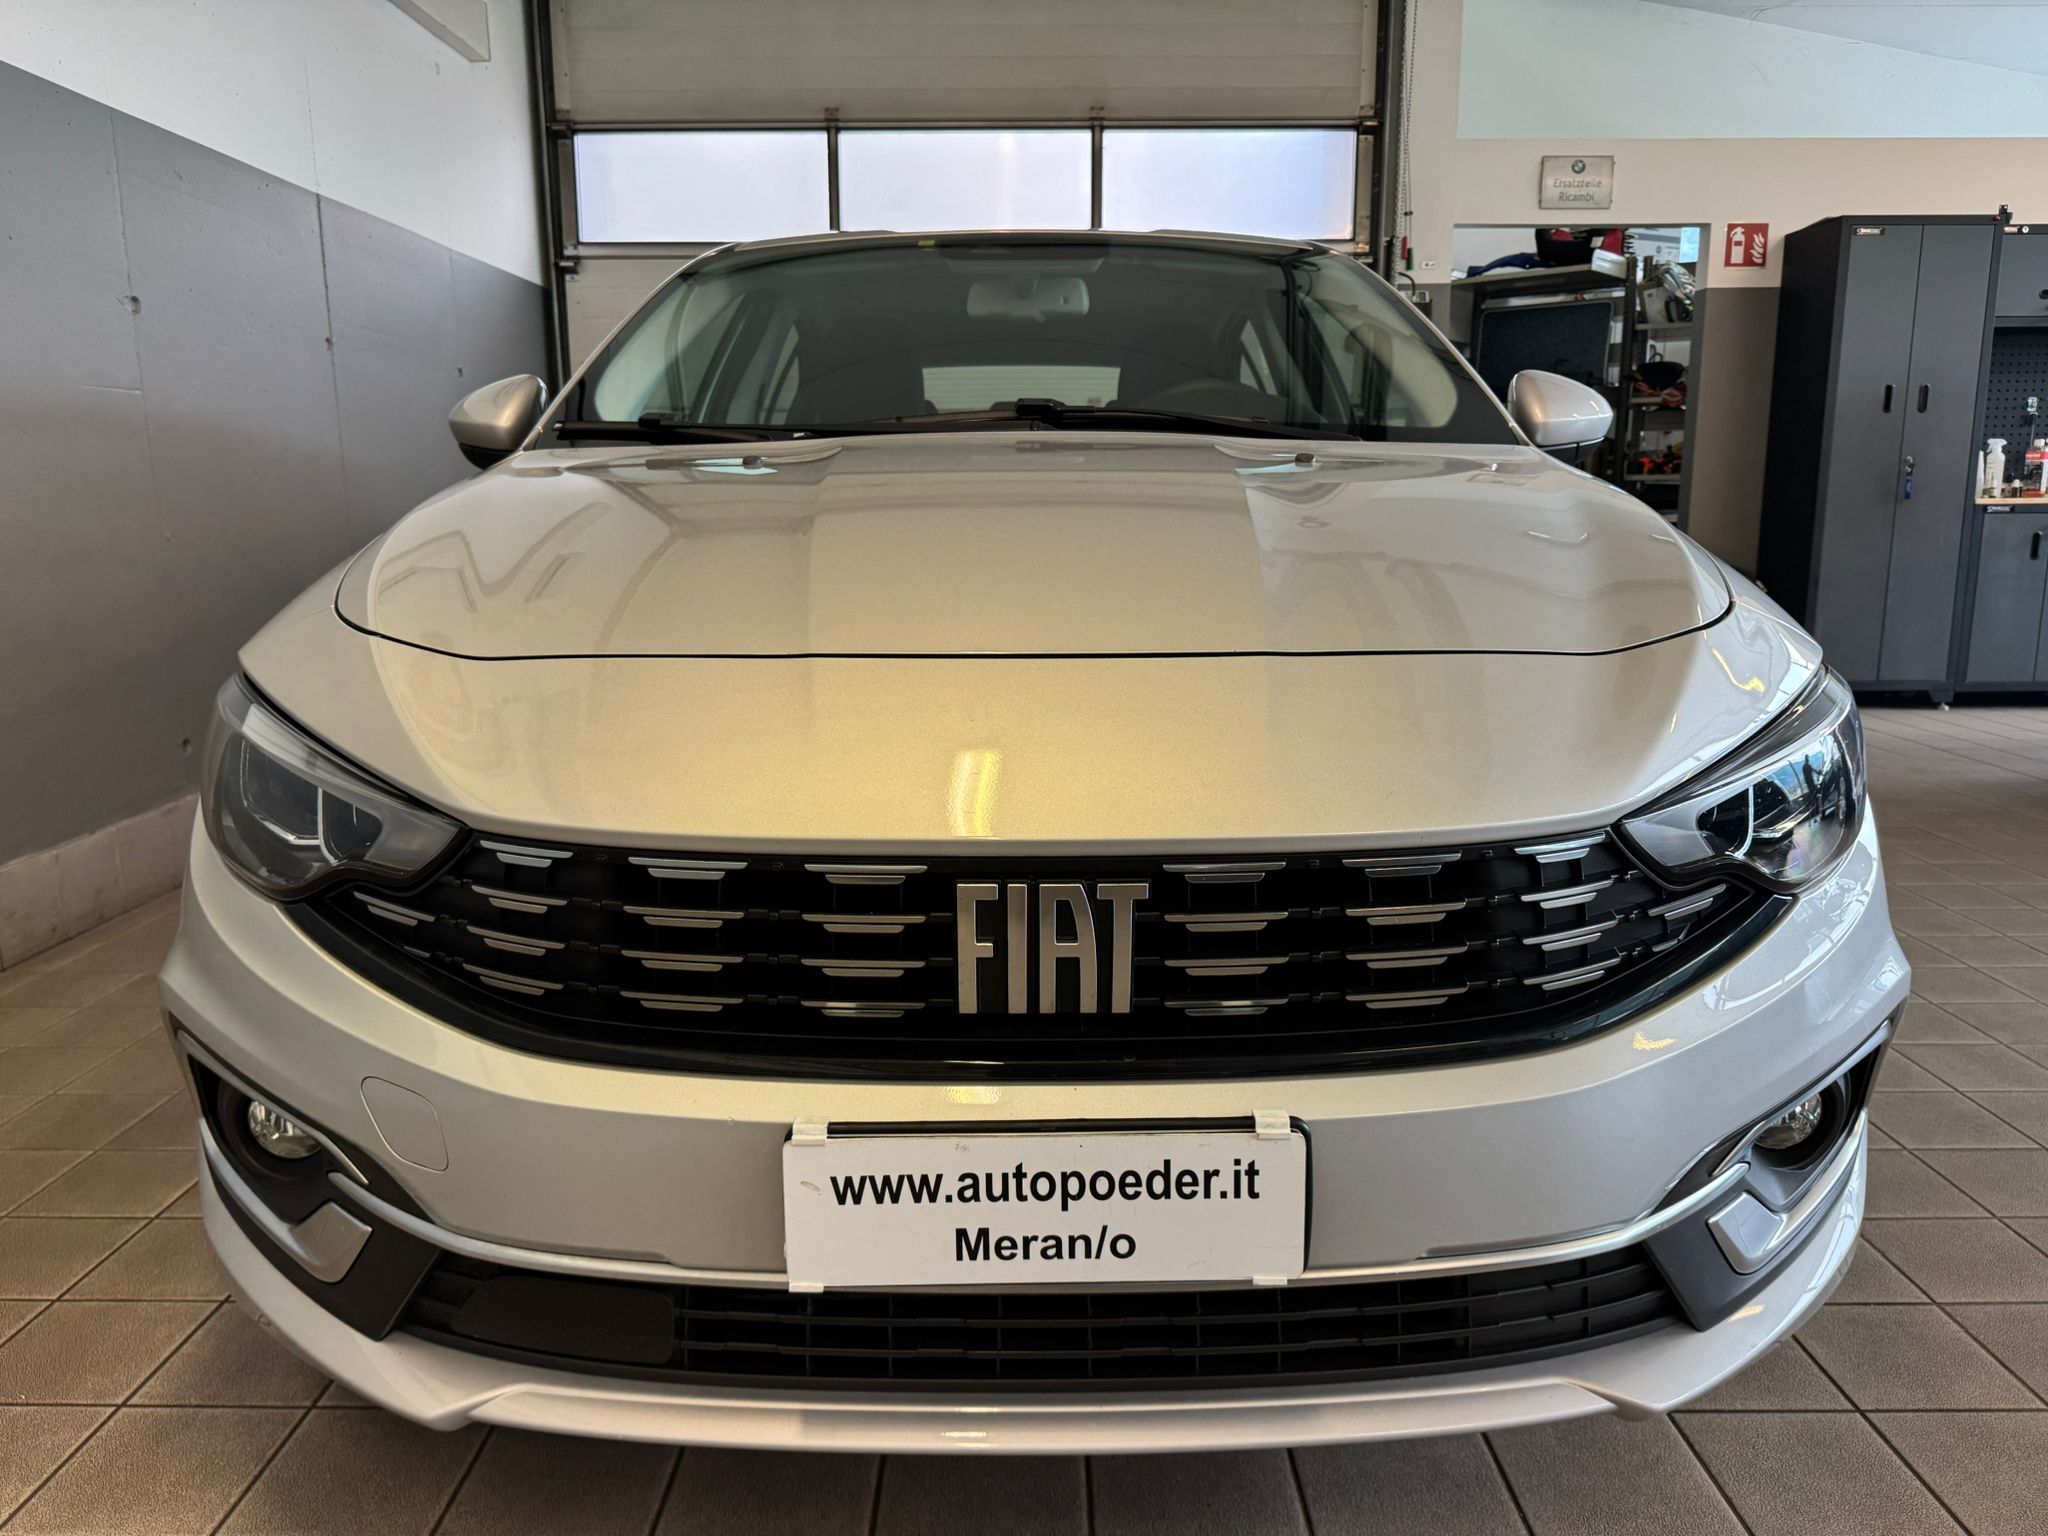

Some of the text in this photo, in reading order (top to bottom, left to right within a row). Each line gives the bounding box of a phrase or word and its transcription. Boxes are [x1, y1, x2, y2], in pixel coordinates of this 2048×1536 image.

[1553, 178, 1602, 188] Ersatzteile
[1559, 191, 1595, 202] Ricambi
[956, 883, 1149, 1014] FIAT
[829, 1158, 1261, 1211] www.autopoeder.it
[954, 1225, 1138, 1262] Meran/o
